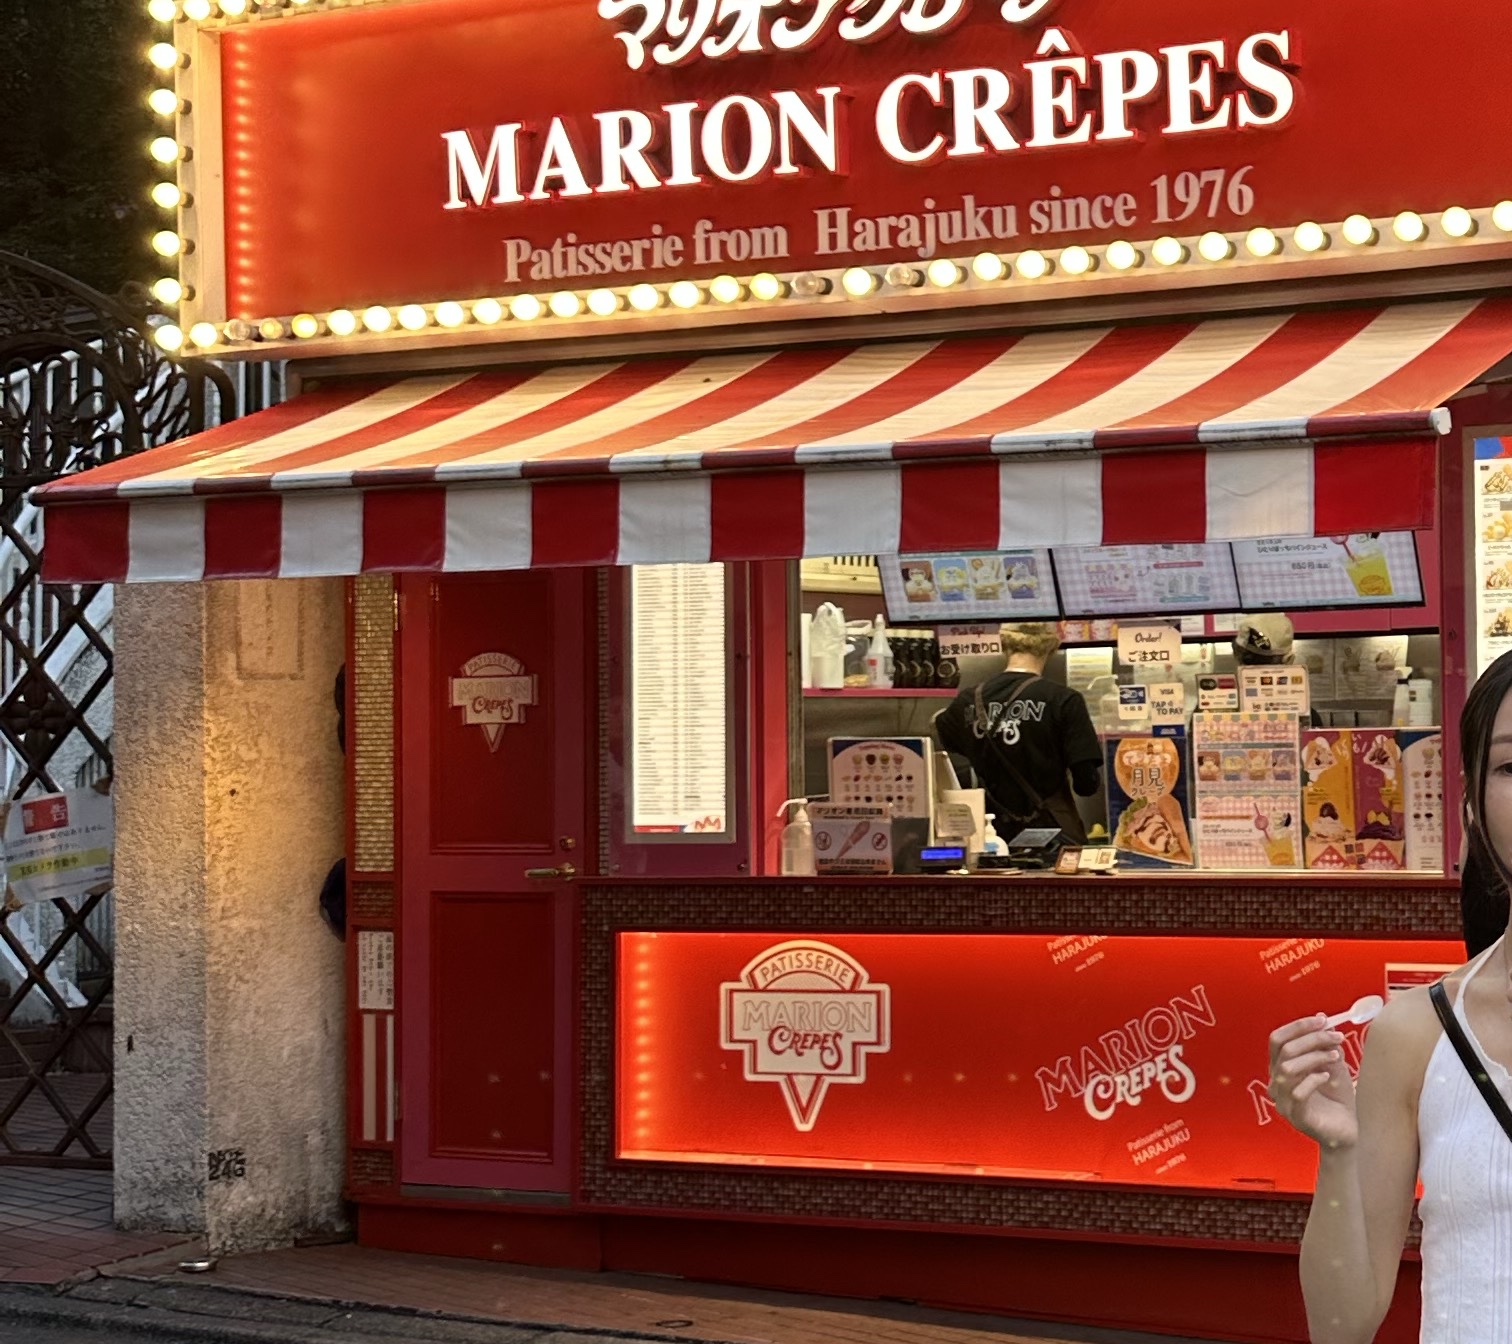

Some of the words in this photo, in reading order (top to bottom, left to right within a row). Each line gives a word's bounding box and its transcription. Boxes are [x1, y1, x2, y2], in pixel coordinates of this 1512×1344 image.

[441, 87, 841, 210] MARION
[875, 26, 1296, 166] CRÊPES
[503, 224, 683, 283] Patisserie
[692, 219, 788, 265] from
[814, 191, 1019, 258] Harajuku
[1030, 185, 1137, 235] since
[1151, 165, 1255, 224] 1976
[1128, 650, 1170, 663] ご注文口
[964, 700, 1046, 723] RON
[1132, 767, 1162, 787] 月見
[760, 952, 851, 983] PATISSERIE
[742, 1000, 873, 1032] MARION
[768, 1025, 844, 1070] CREPES
[1035, 984, 1216, 1111] MARION
[1084, 1044, 1197, 1121] CREPES
